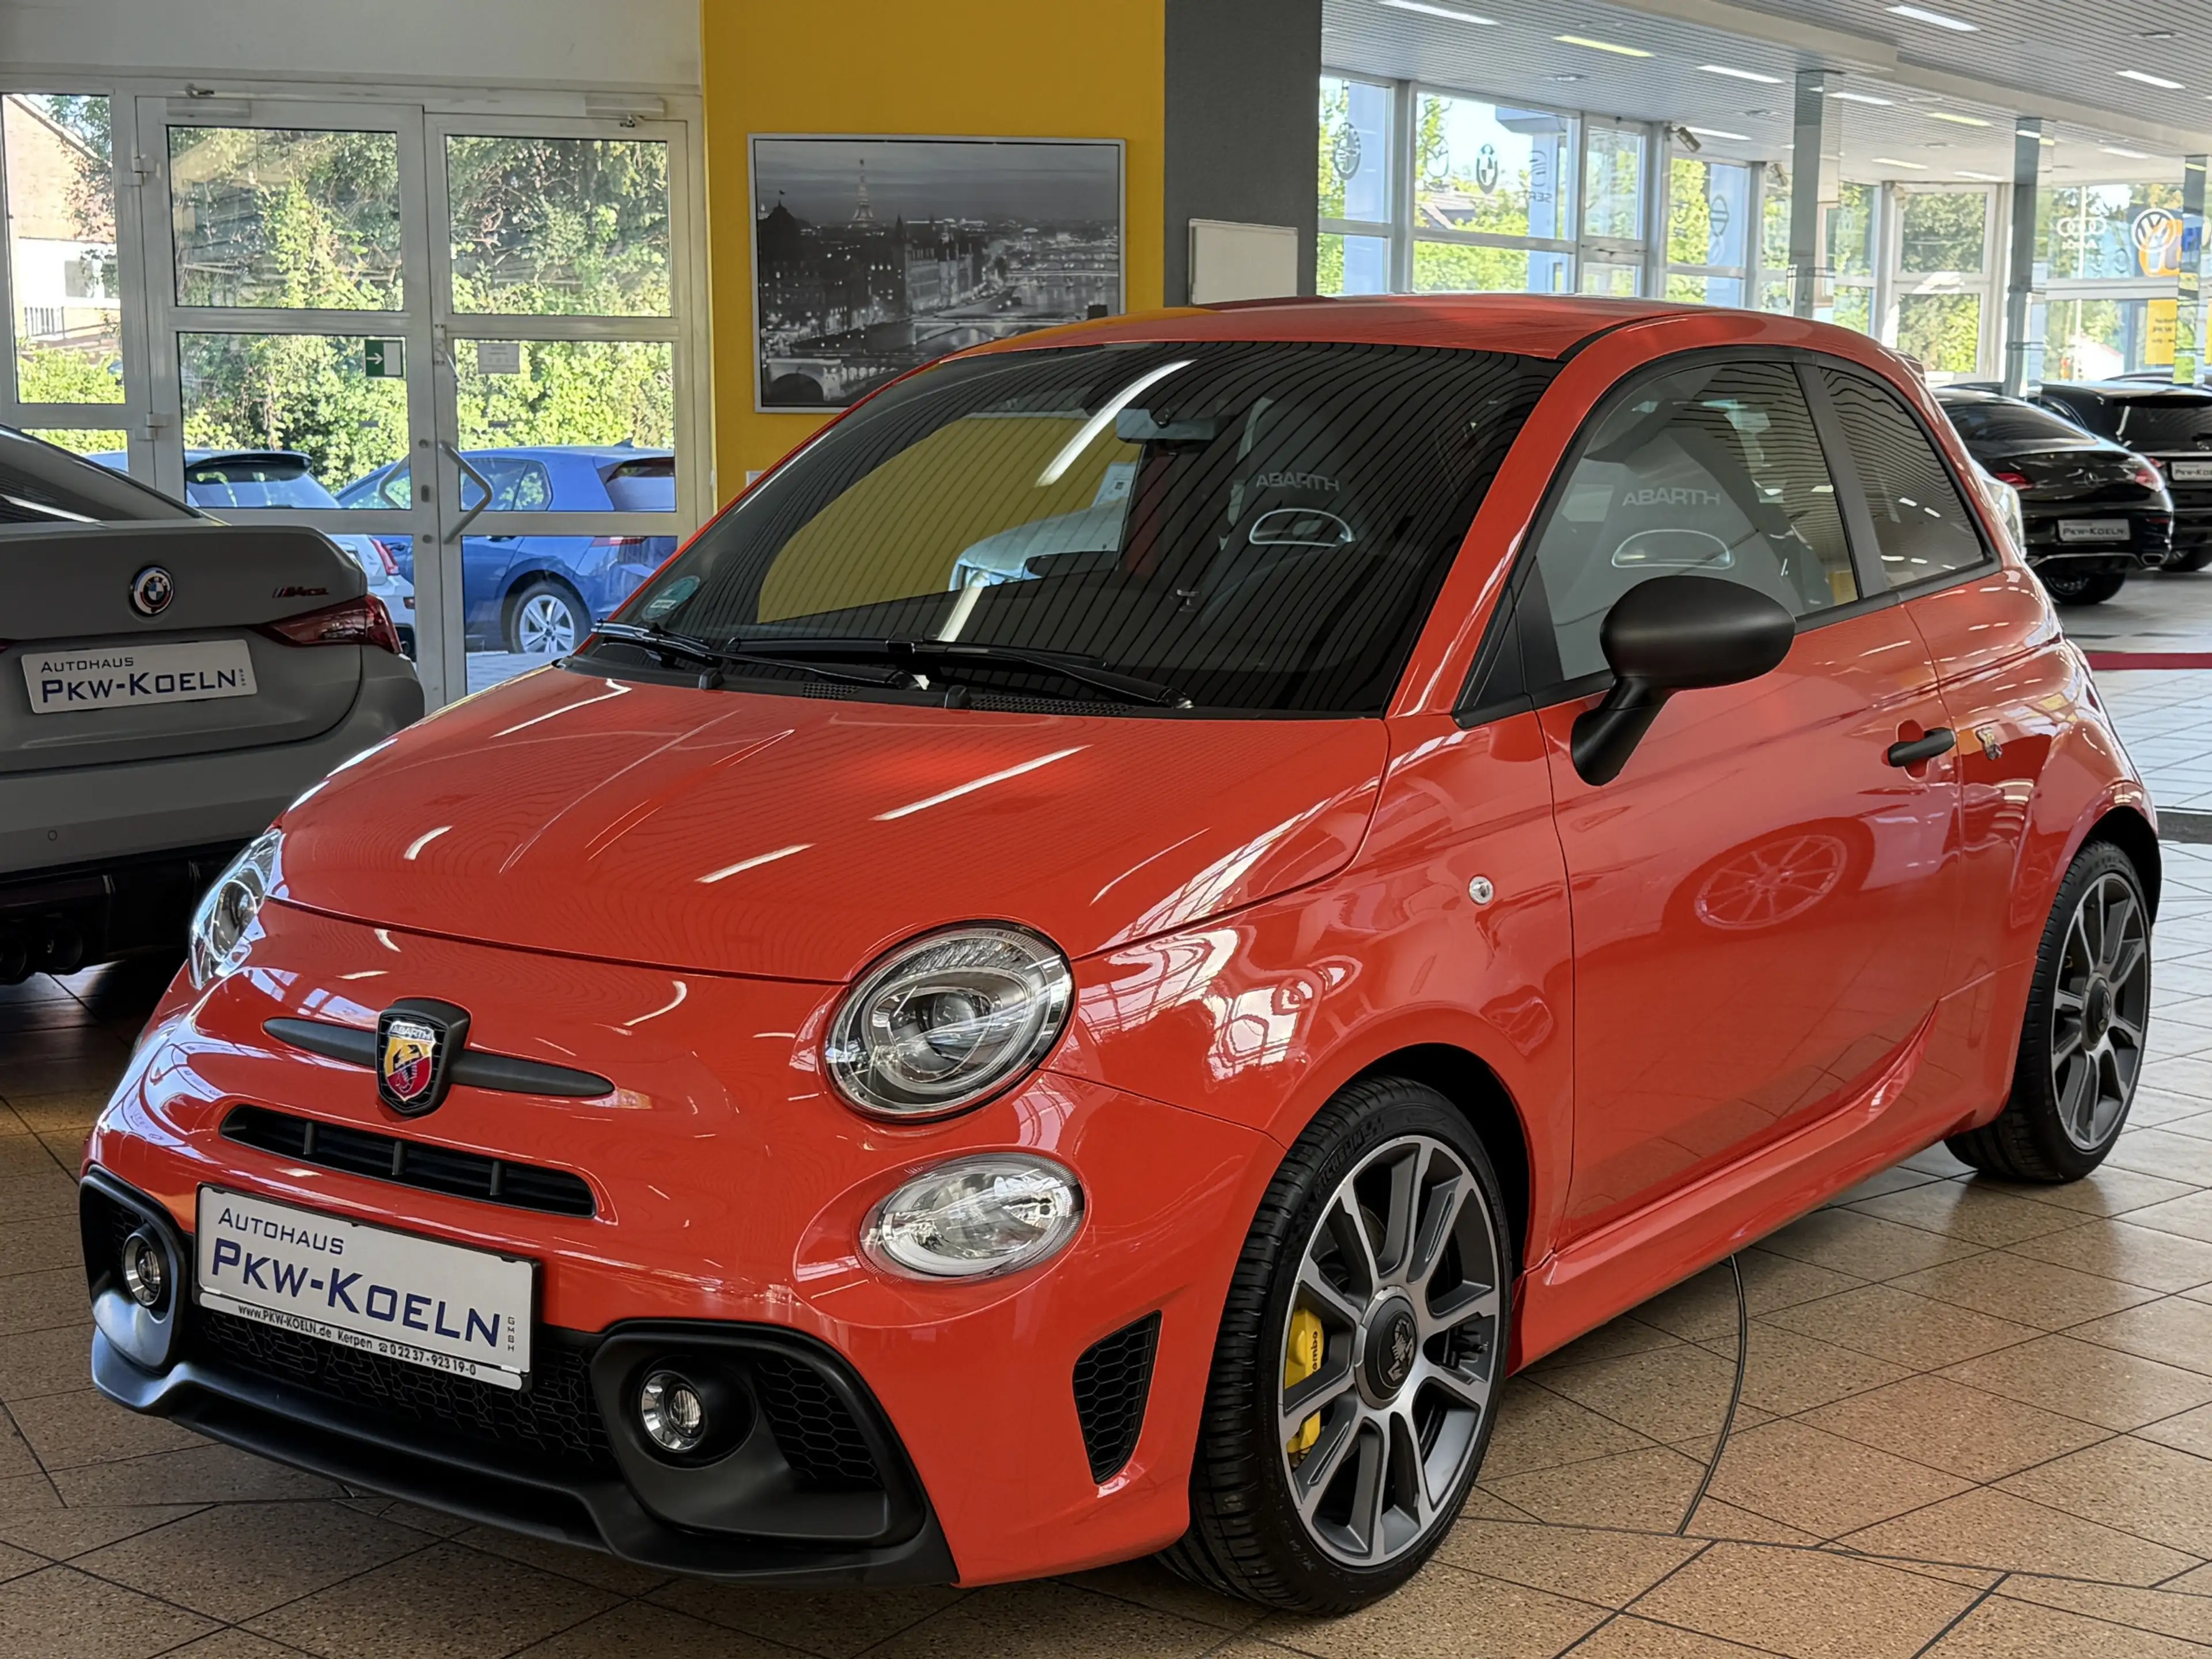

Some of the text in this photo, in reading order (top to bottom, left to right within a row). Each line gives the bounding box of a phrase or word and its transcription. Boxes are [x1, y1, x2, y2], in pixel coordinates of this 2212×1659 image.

[1256, 472, 1340, 491] ABARTH
[1622, 487, 1720, 506] ABARTH
[40, 657, 134, 673] AUTOHAUS
[42, 669, 237, 703] PKW-KOELN
[392, 1025, 432, 1040] ABARTH
[218, 1207, 344, 1255] AUTOHAUS
[211, 1237, 501, 1348] PKW-KOELN
[238, 1305, 332, 1338] www.PKW-KOELN.de
[337, 1329, 373, 1349] Kerpen
[507, 1316, 516, 1352] GMBH
